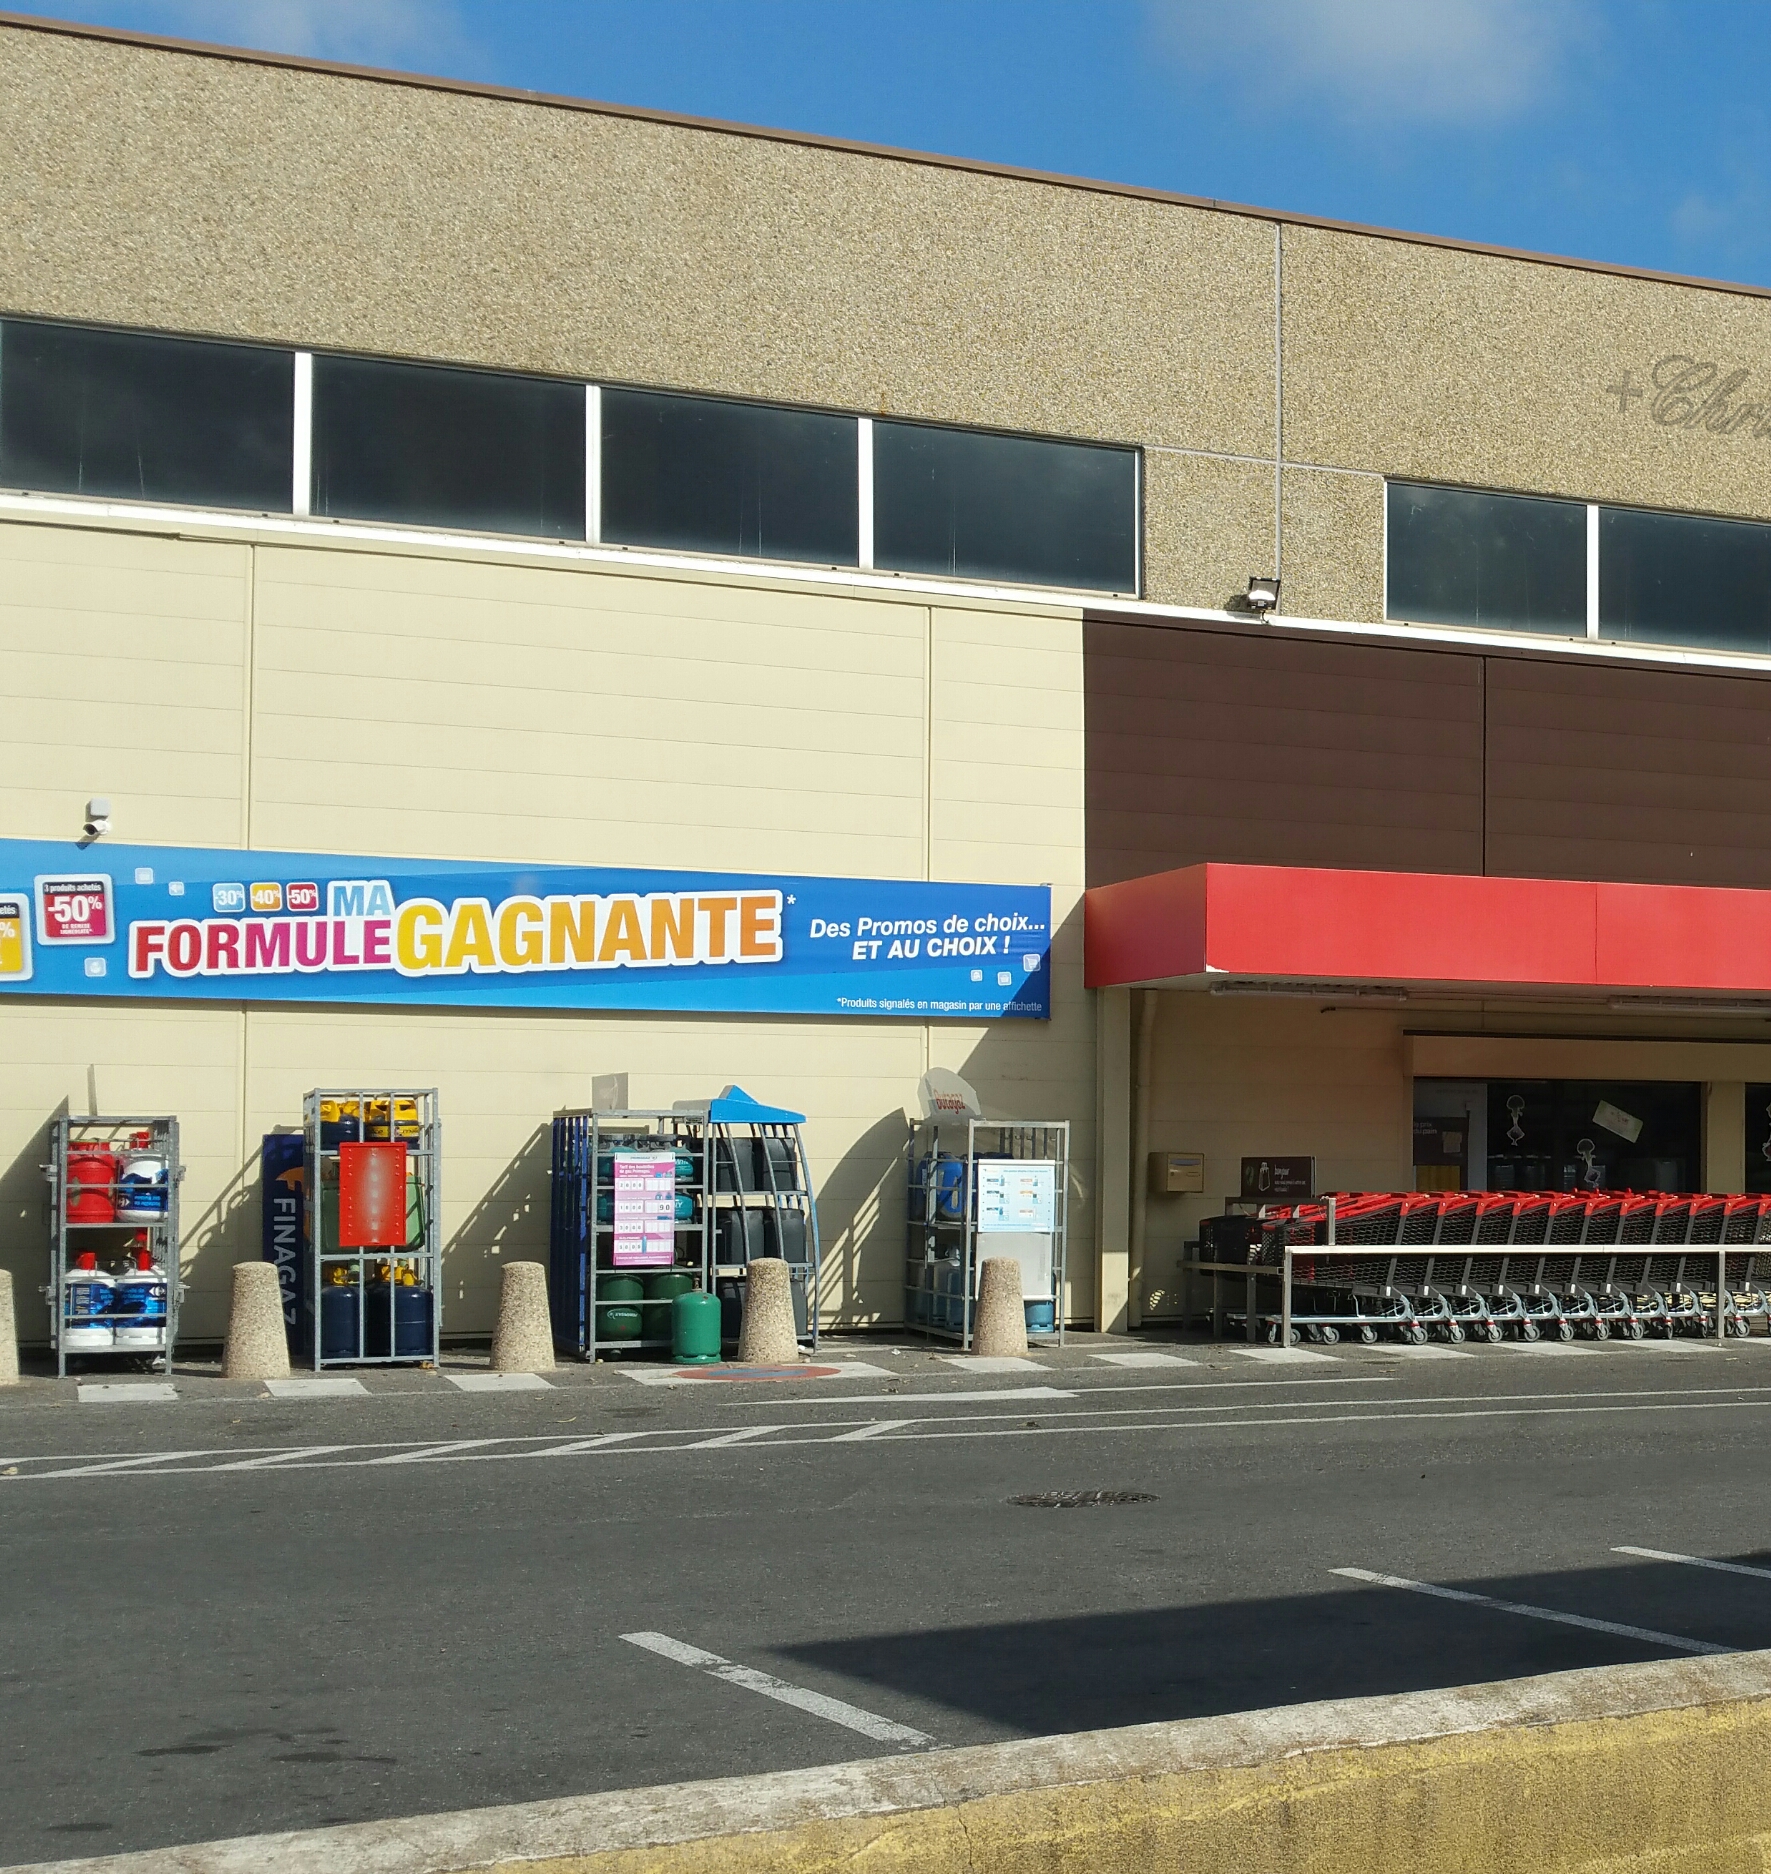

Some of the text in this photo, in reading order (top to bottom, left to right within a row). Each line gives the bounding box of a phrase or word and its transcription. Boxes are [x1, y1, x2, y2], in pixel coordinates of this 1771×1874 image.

[50, 884, 76, 893] produits
[77, 882, 102, 891] achetés
[214, 889, 244, 905] -30%
[251, 889, 280, 905] -40%
[288, 888, 317, 905] -50%
[47, 895, 102, 922] -50%
[333, 885, 391, 917] MA
[809, 912, 1045, 938] Des Promos de choix...
[135, 919, 392, 972] FORMULE
[852, 940, 882, 960] ET
[887, 938, 920, 959] AU
[926, 936, 998, 958] CHOIX
[879, 997, 915, 1011] signalés
[917, 1000, 928, 1009] en
[930, 1000, 967, 1012] magasin
[969, 1001, 983, 1012] par
[985, 1002, 1001, 1011] une
[1002, 999, 1042, 1012] affichette
